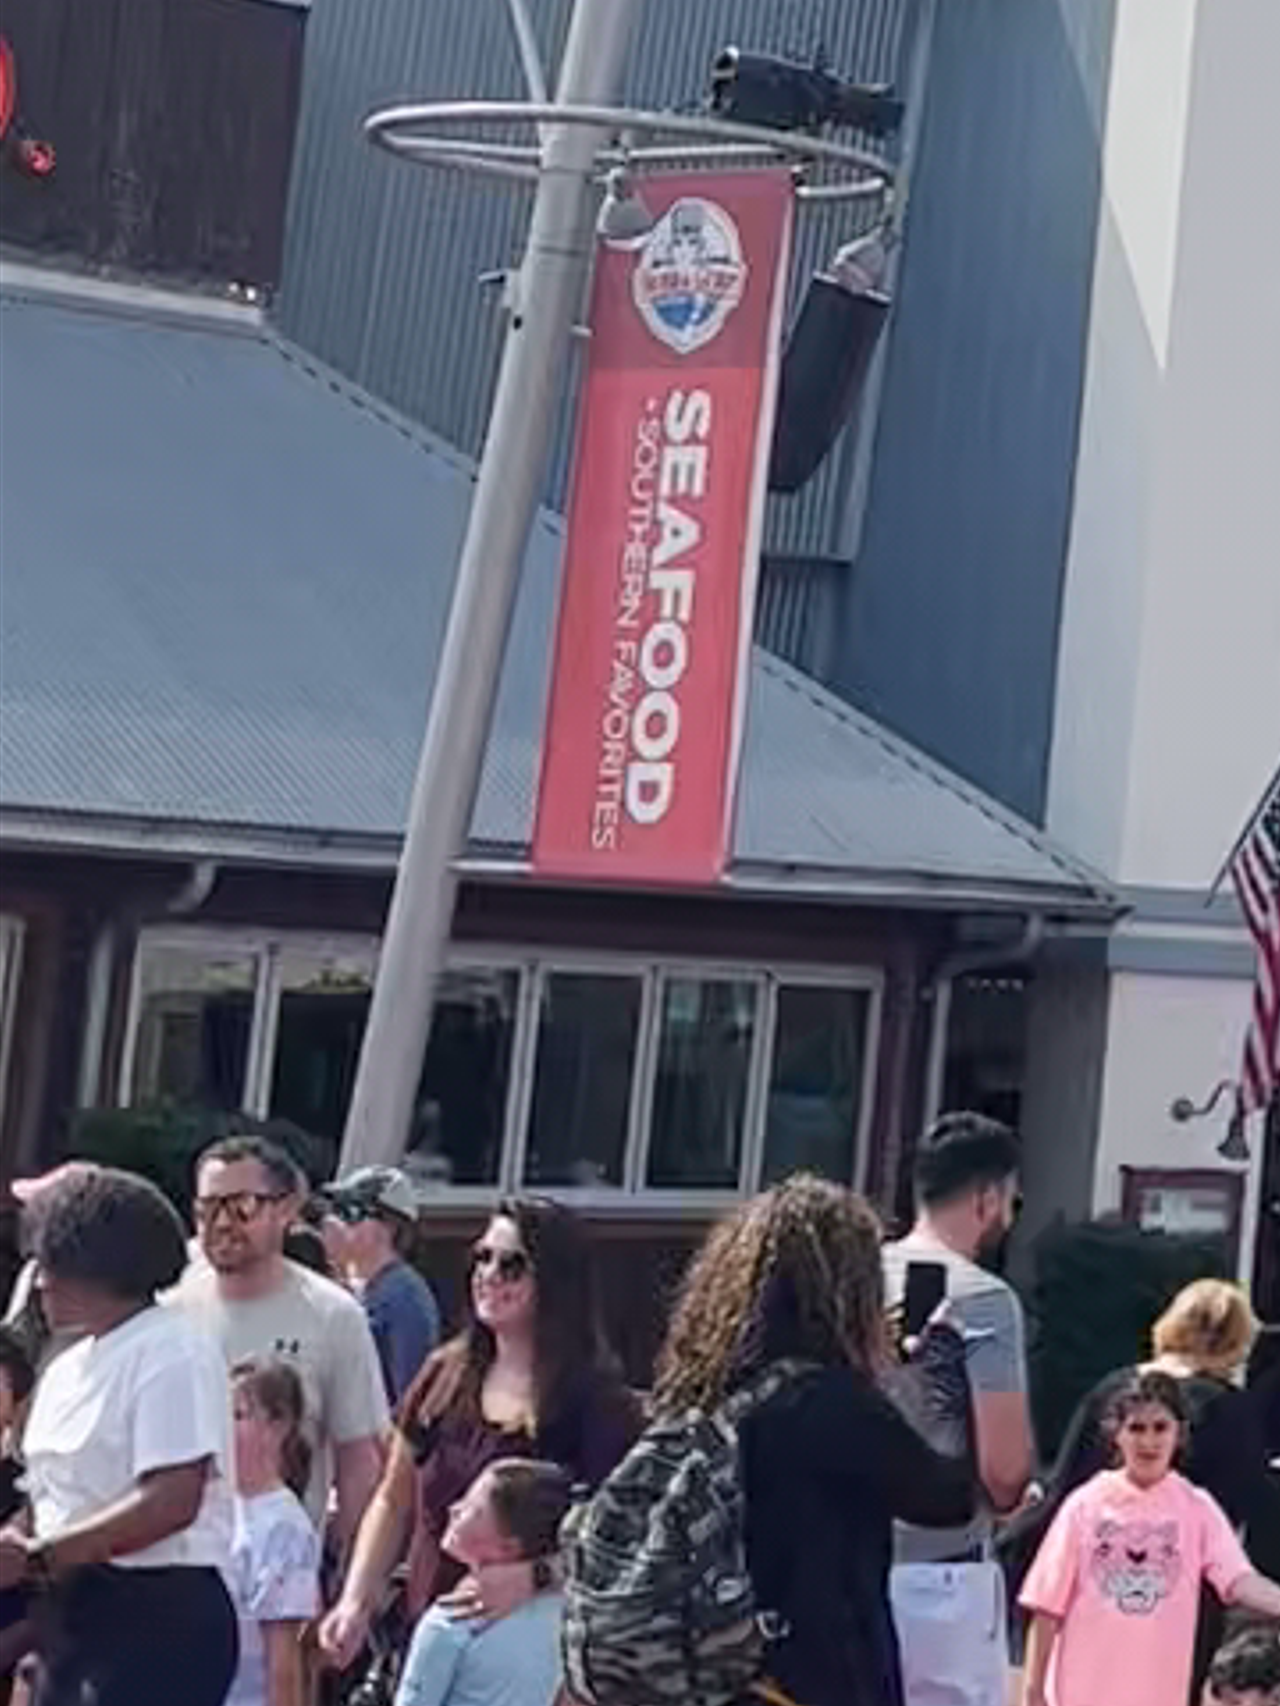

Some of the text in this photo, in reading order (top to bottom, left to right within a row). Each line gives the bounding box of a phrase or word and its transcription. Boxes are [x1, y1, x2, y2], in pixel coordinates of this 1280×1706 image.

[591, 420, 661, 850] SOUTHERN FAVORITES
[624, 388, 711, 825] SEAFOOD
